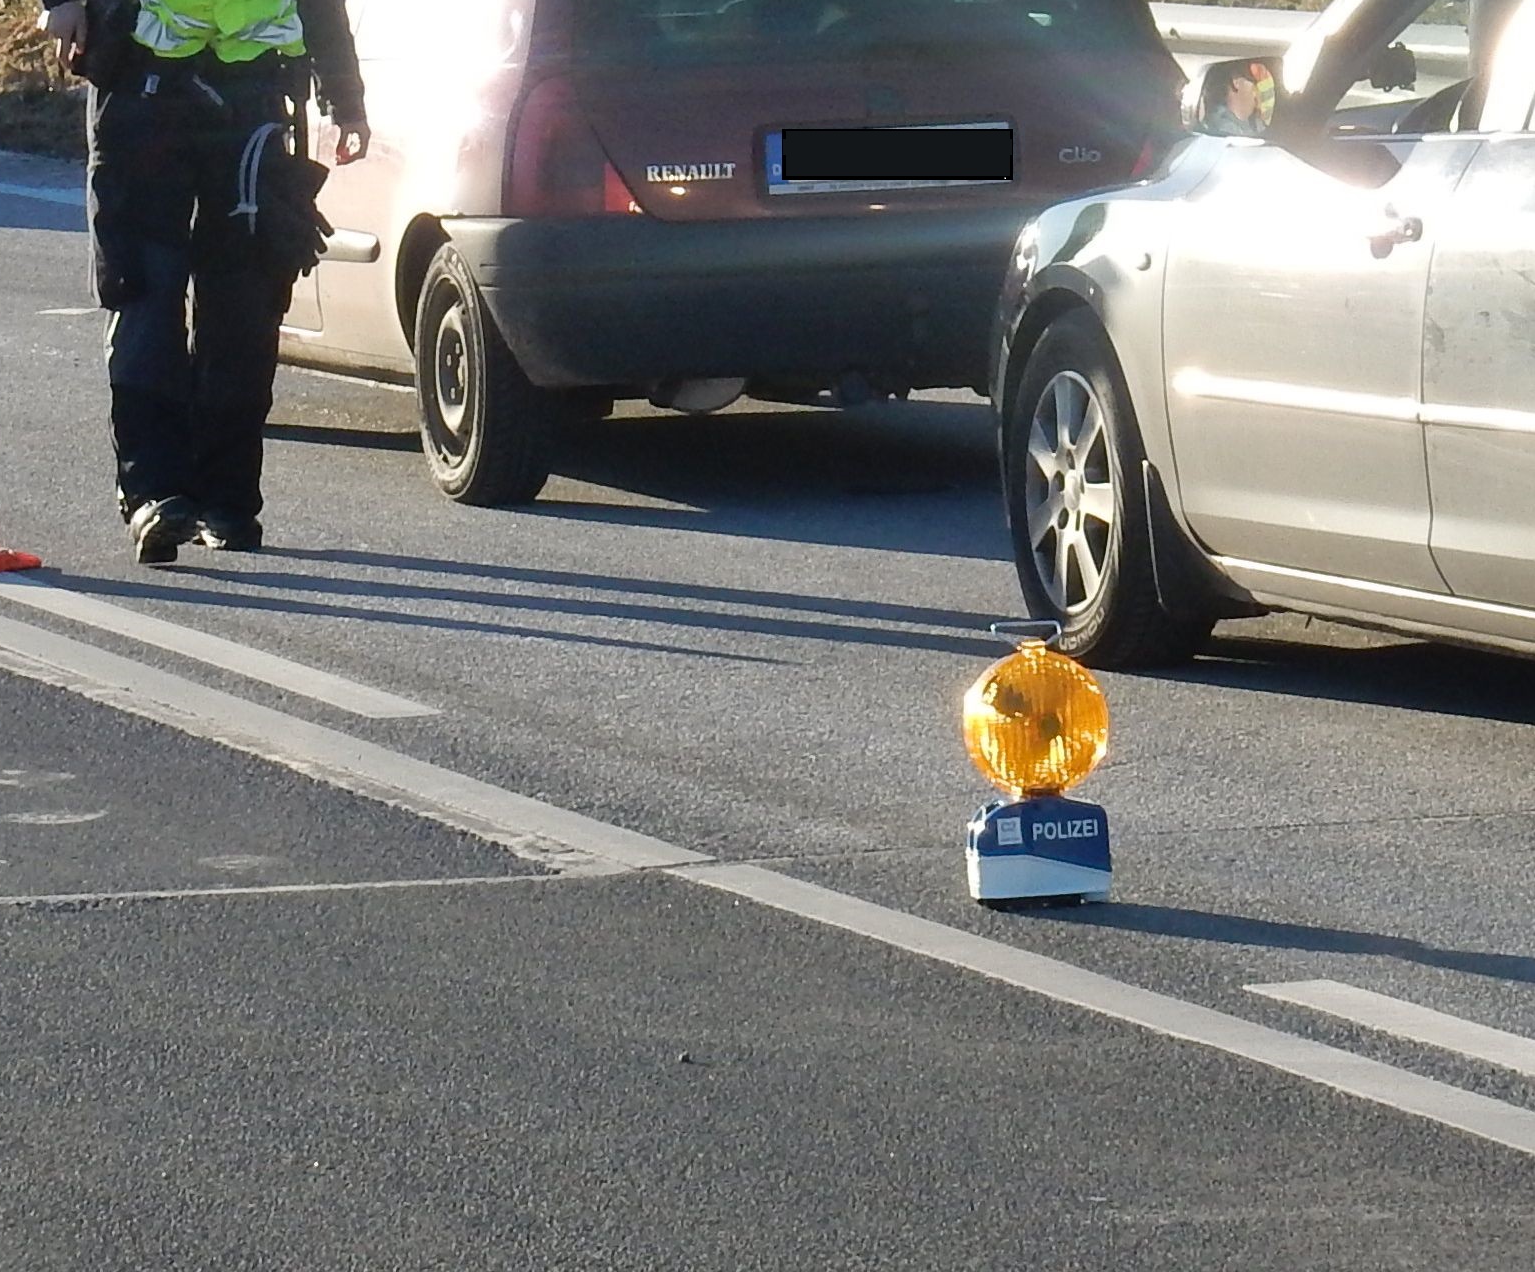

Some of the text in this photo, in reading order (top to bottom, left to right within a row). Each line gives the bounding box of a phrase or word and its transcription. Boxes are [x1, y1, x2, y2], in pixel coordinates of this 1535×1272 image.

[1058, 146, 1101, 164] Clio
[646, 162, 736, 182] RENAULT
[1032, 818, 1099, 841] POLIZEI
